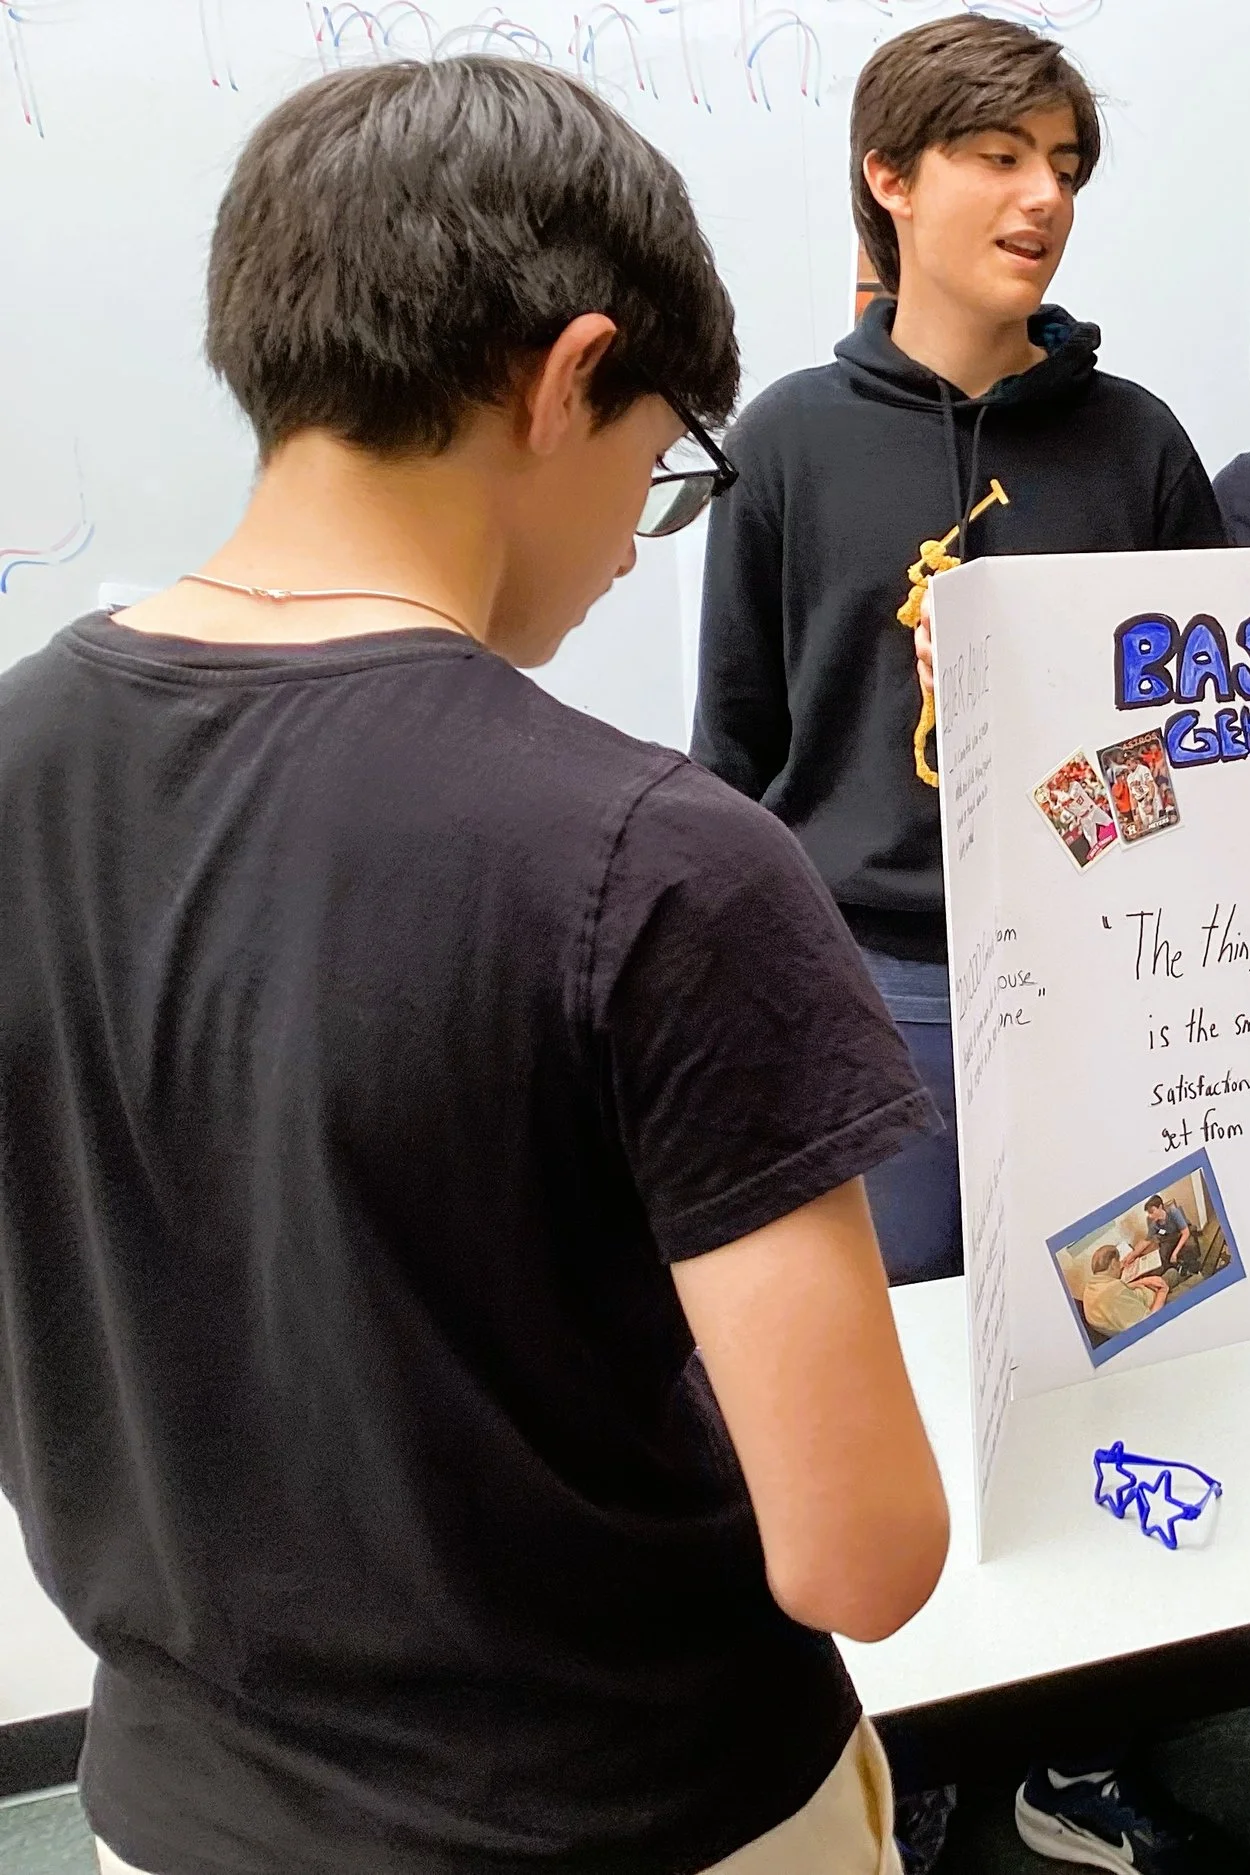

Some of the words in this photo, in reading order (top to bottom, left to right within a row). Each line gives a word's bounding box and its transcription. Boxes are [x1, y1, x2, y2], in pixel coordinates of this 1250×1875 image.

[1149, 1014, 1170, 1050] is
[1186, 1007, 1219, 1043] the
[1151, 1070, 1250, 1106] satisfaction
[1161, 1118, 1193, 1152] get
[1200, 1108, 1243, 1142] from
